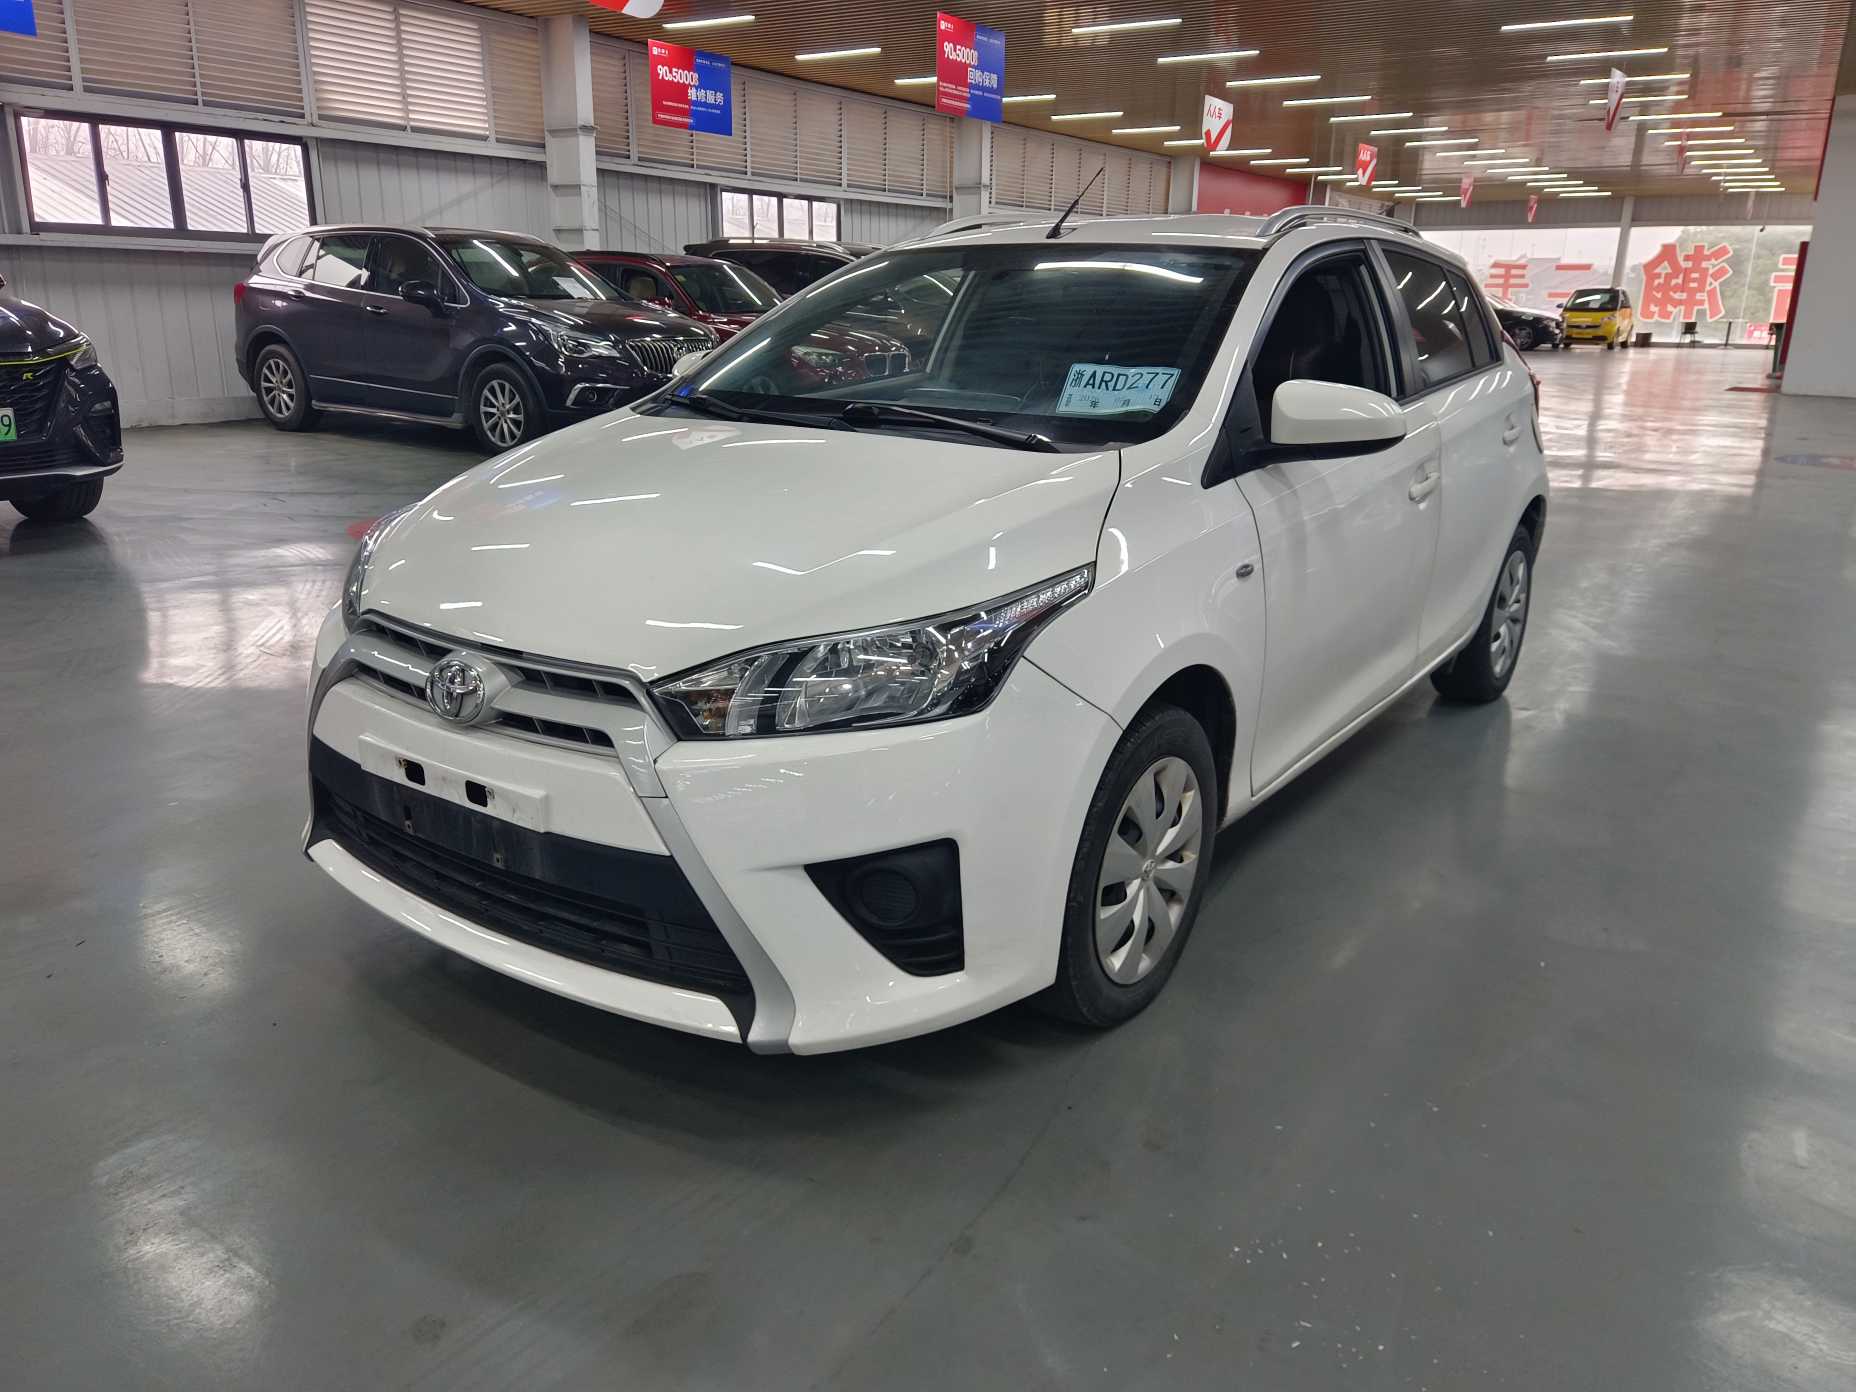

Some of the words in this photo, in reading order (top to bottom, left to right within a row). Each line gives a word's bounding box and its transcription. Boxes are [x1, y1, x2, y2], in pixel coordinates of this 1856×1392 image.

[687, 86, 724, 105] 维修服务
[1206, 103, 1224, 121] 人人车
